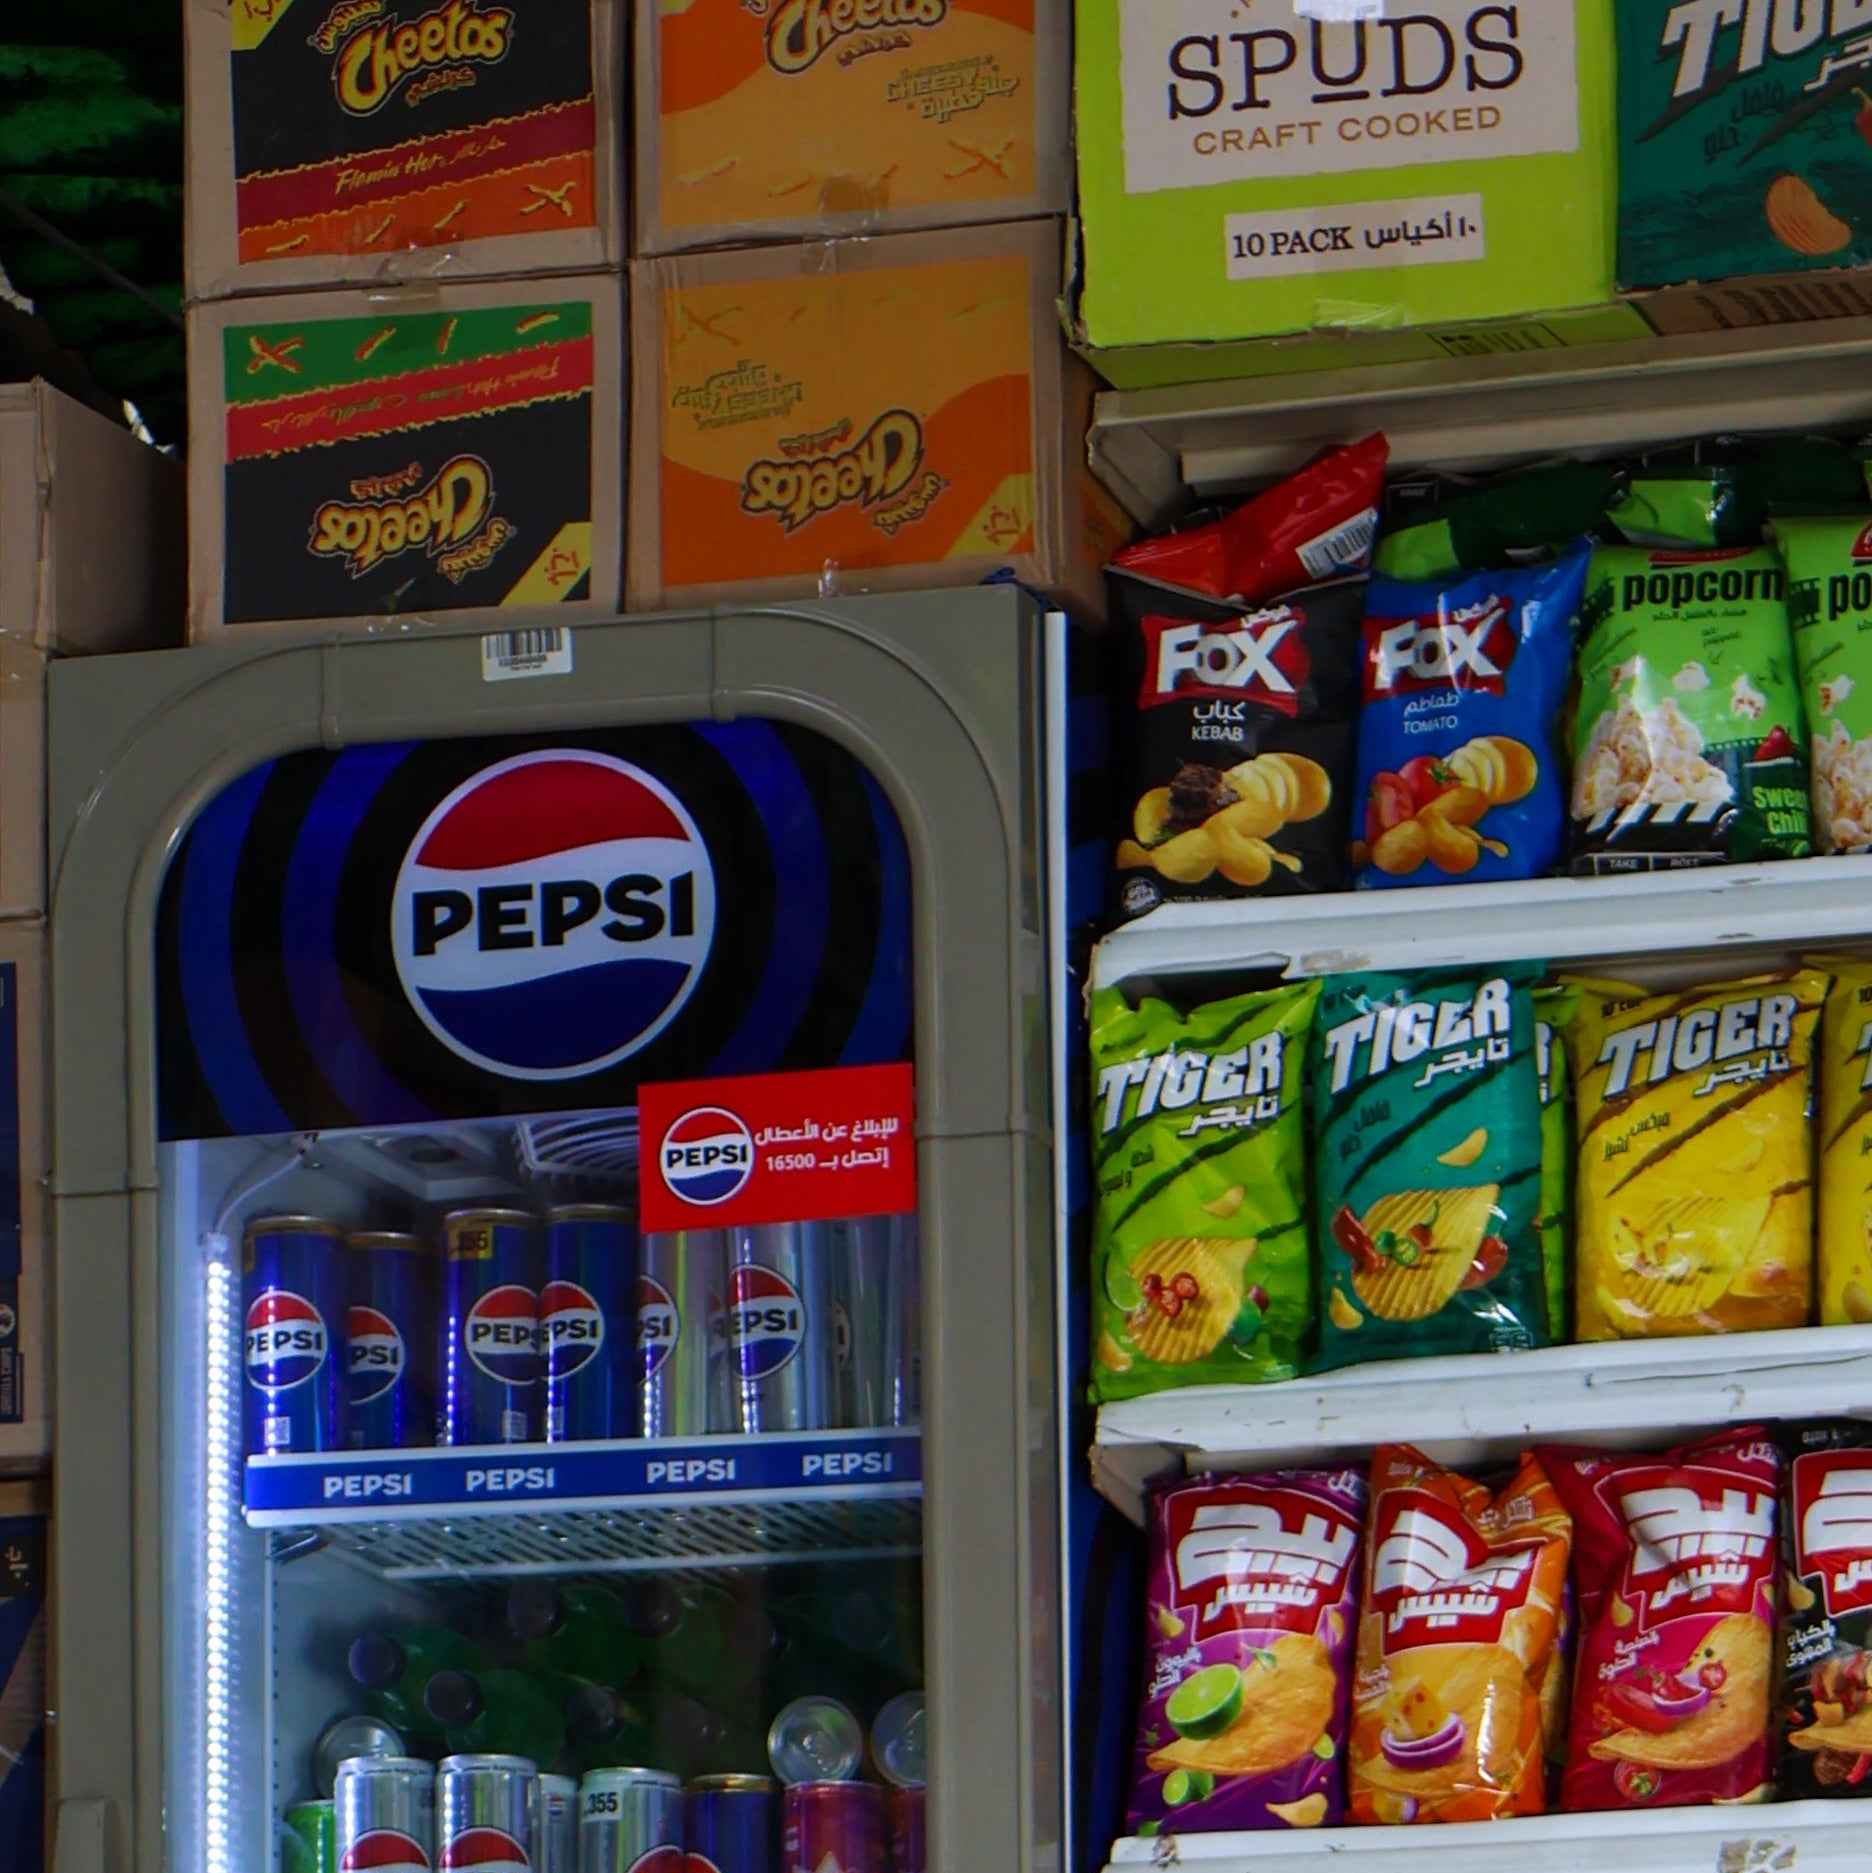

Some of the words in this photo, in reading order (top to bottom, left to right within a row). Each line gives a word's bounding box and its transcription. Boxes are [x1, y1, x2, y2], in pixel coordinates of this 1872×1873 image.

[337, 3, 514, 114] Cheetos
[1167, 4, 1526, 121] SPUDS
[1192, 121, 1322, 156] CRAFT
[1337, 105, 1503, 144] COOKED
[1232, 232, 1266, 260] 10
[1270, 225, 1354, 255] PACK
[741, 411, 924, 535] Cheetos
[309, 454, 498, 577] Cheetos
[1623, 568, 1785, 610] popcorn
[1156, 619, 1299, 694] FOX
[1373, 609, 1506, 692] FOX
[1191, 725, 1244, 742] KEBAB
[1193, 702, 1246, 724] كباب
[1403, 715, 1458, 735] TOMATO
[412, 870, 695, 957] PEPSI
[1325, 978, 1511, 1095] TIGER
[1600, 993, 1798, 1098] TIGER
[1098, 1031, 1284, 1134] TIGER
[666, 1143, 747, 1168] PEPSI
[755, 1119, 819, 1146] الأعطال
[822, 1122, 848, 1141] عن
[767, 1153, 815, 1171] 16500
[246, 1329, 324, 1358] PEPSI
[324, 1472, 413, 1499] PEPSI
[465, 1466, 555, 1493] PEPSI
[646, 1459, 736, 1484] PEPSI
[802, 1451, 892, 1477] PEPSI
